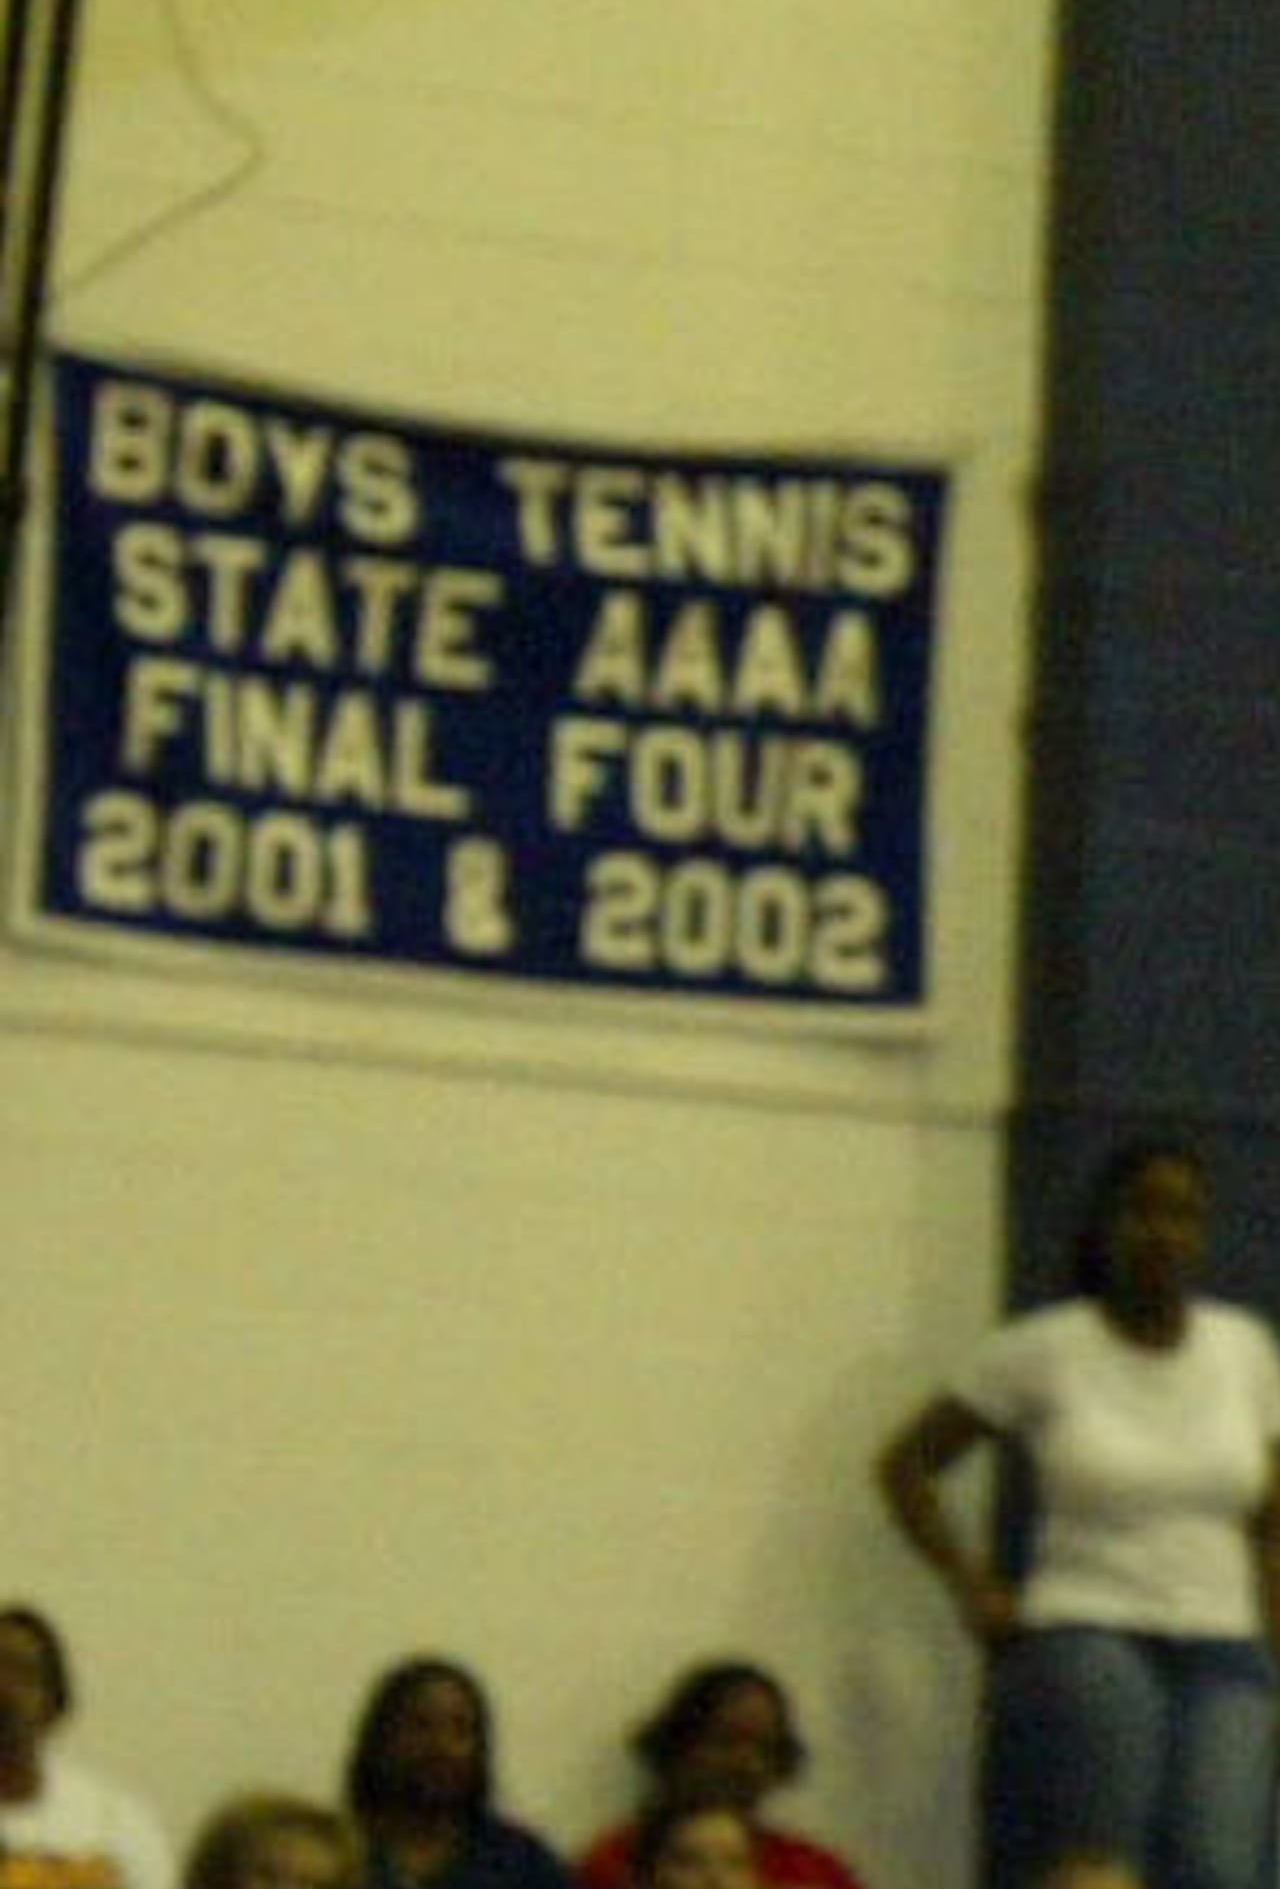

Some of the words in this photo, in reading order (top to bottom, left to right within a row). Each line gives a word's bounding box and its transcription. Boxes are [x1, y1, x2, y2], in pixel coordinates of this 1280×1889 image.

[88, 383, 420, 547] BOYS
[498, 459, 916, 596] TENNIS
[109, 523, 502, 690] STATE
[574, 591, 879, 727] AAAA
[121, 657, 471, 820] FINAL
[547, 719, 862, 856] FOUR
[78, 791, 371, 938] 2001
[443, 836, 513, 954] &
[580, 852, 887, 991] 2002
